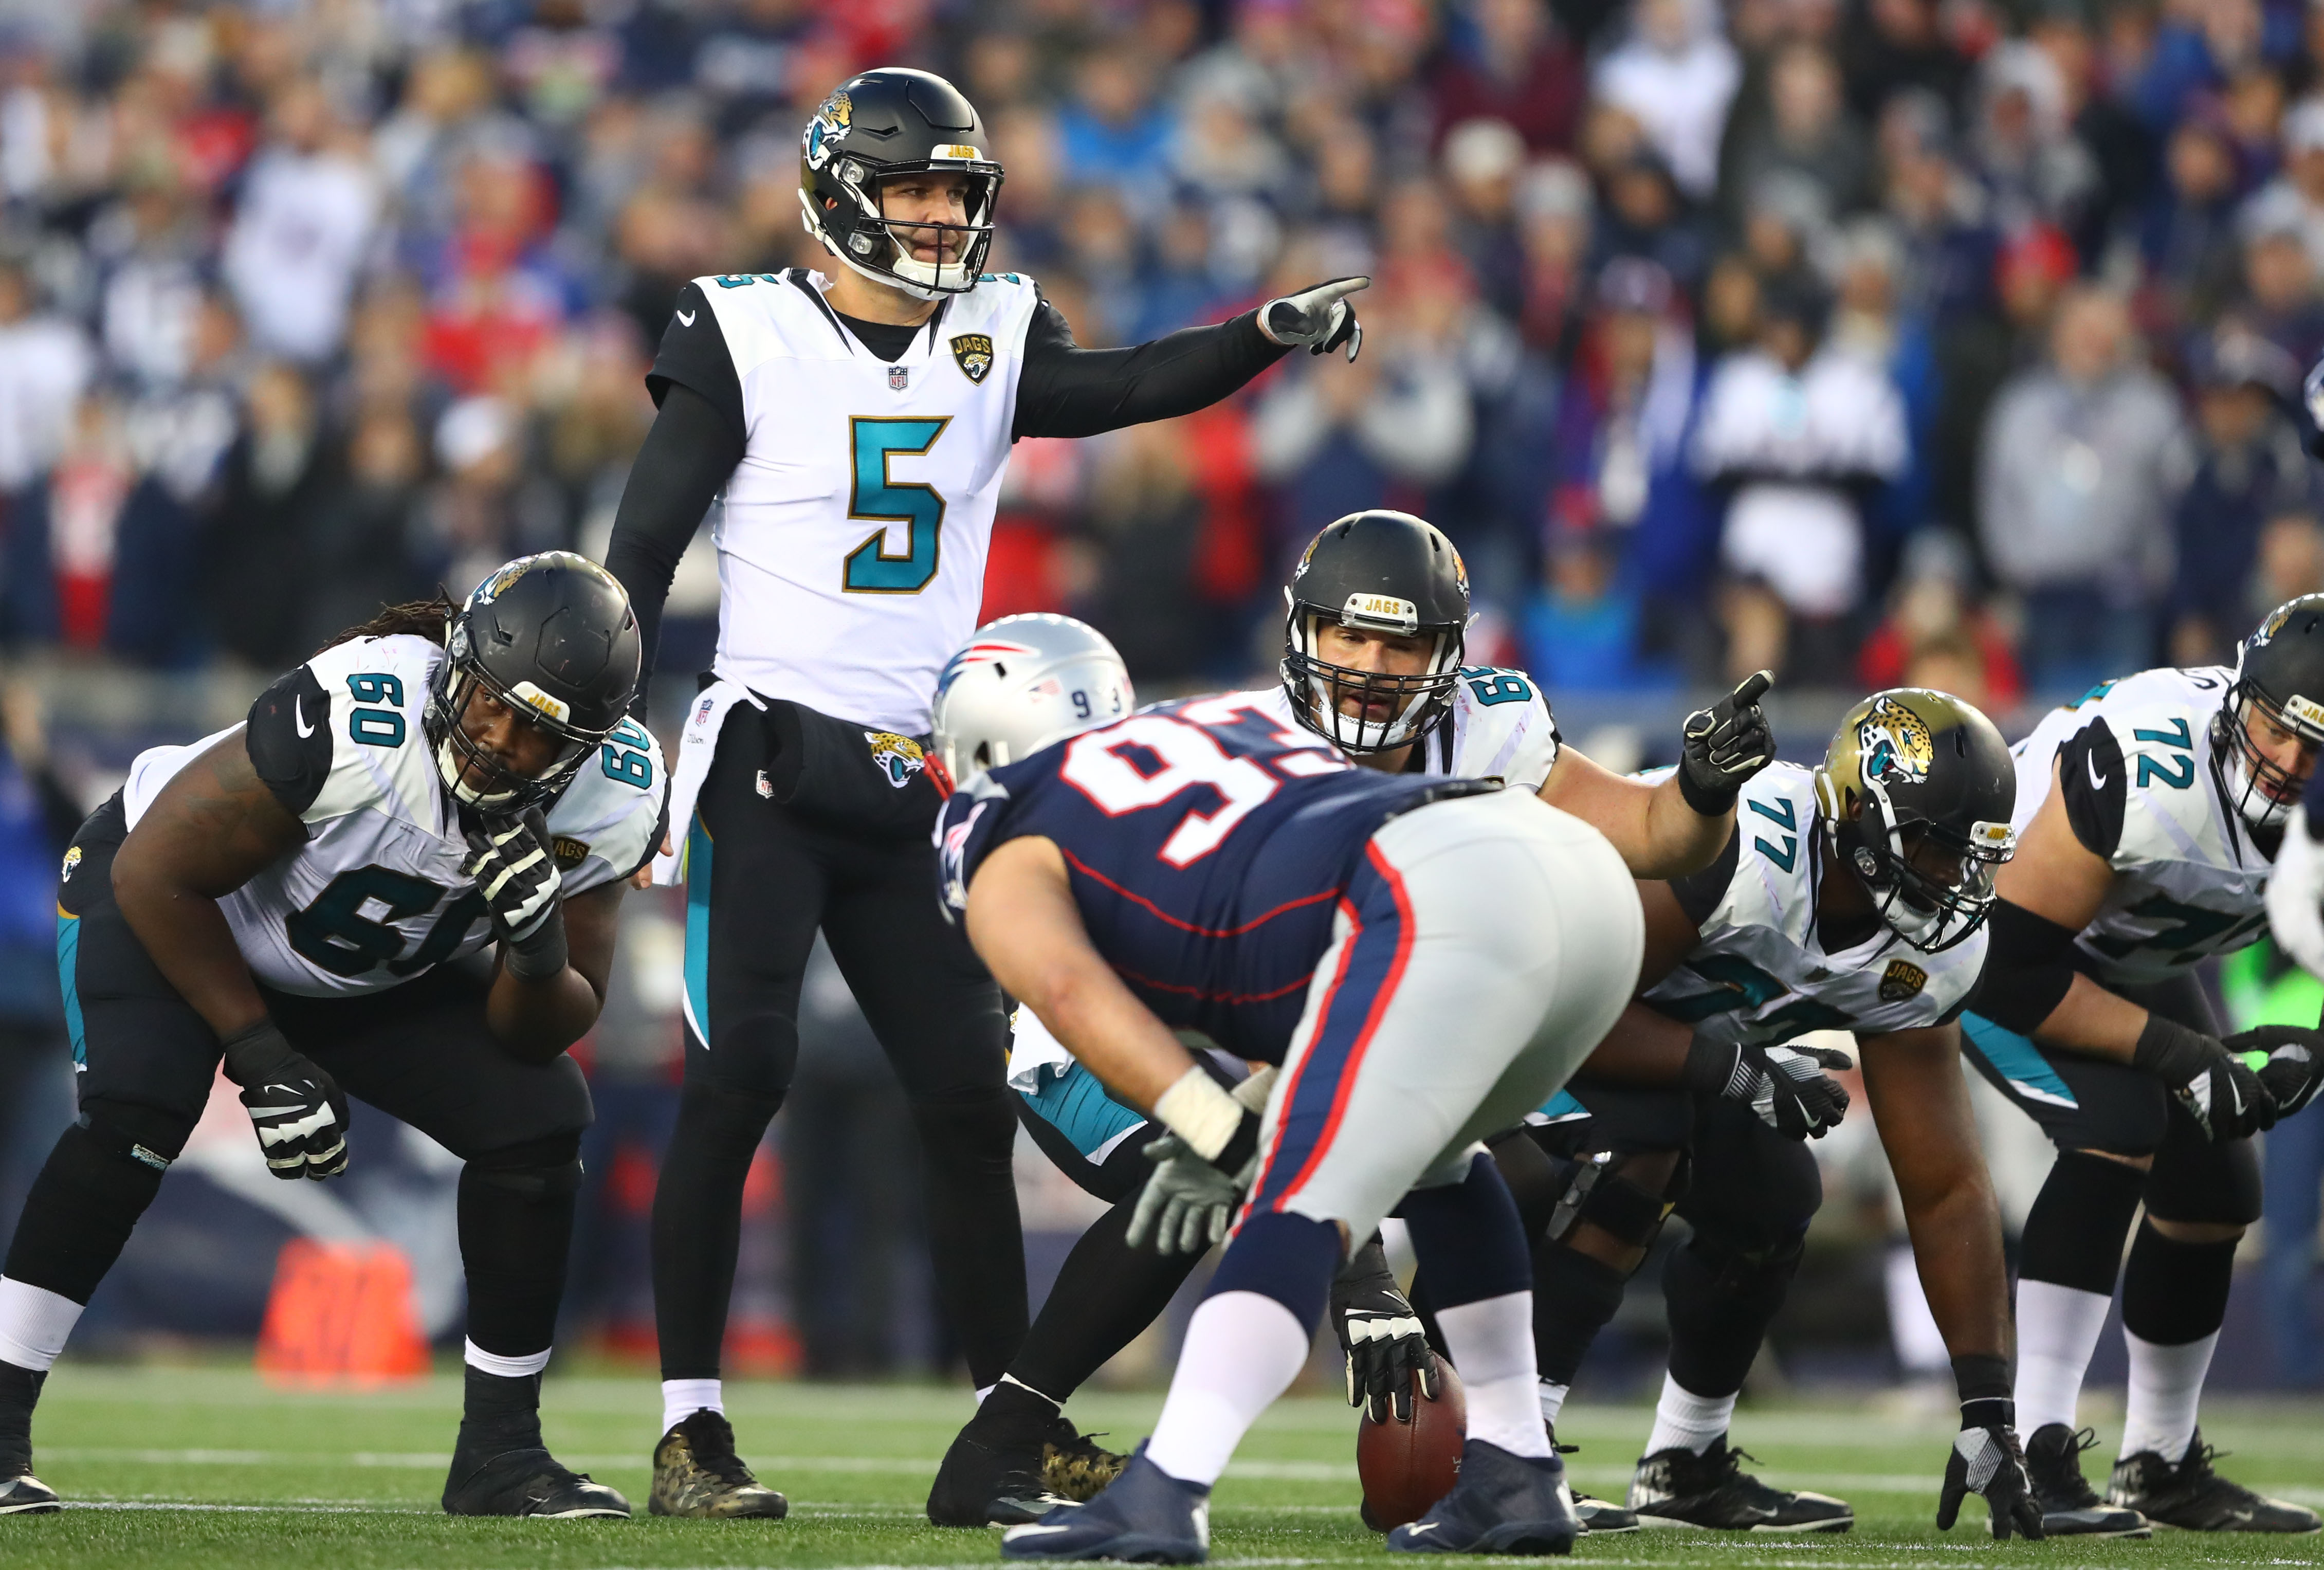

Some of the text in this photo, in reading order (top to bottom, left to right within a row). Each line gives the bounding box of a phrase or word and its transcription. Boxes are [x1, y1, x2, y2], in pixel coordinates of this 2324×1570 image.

[948, 144, 975, 159] JAGS
[954, 336, 991, 354] JAGS
[890, 375, 906, 388] NFL
[841, 415, 955, 595] 5
[1365, 598, 1400, 615] JAGS
[346, 672, 405, 749] 60
[528, 693, 562, 718] JAGS
[601, 719, 652, 790] 60
[2133, 717, 2194, 789] 72
[761, 780, 773, 793] NF
[1058, 690, 1356, 870] 93
[1747, 797, 1797, 873] 77
[555, 840, 585, 859] AGS
[1886, 960, 1924, 988] JAGS
